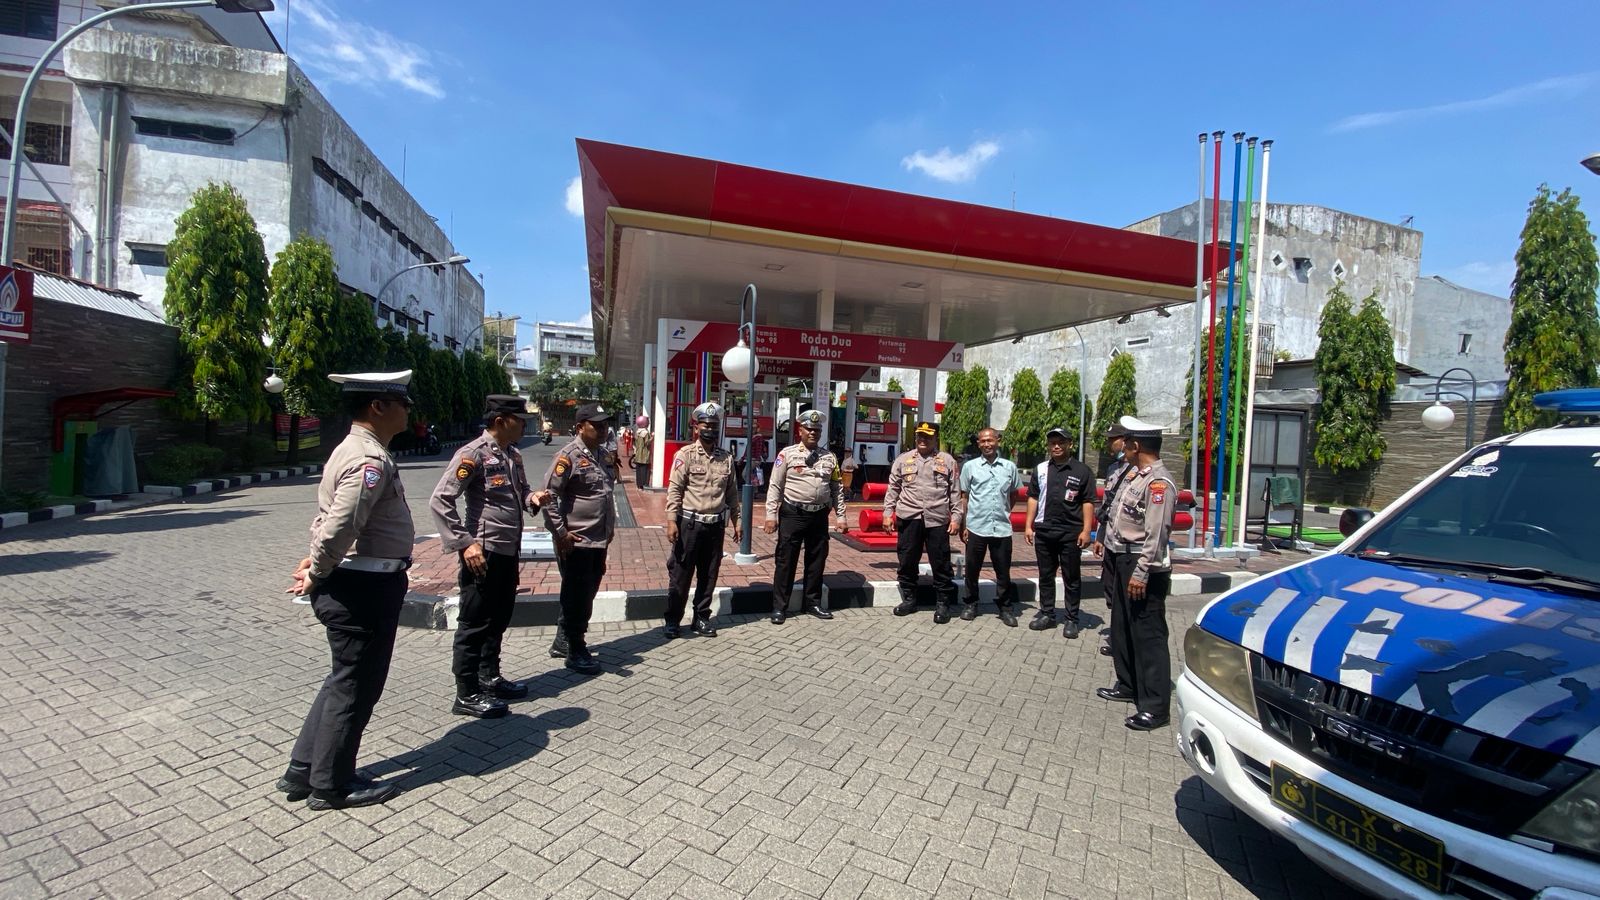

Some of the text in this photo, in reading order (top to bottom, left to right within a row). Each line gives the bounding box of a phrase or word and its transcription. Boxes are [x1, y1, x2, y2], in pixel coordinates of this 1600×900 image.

[800, 332, 852, 347] Roda Dua
[809, 345, 843, 359] Motor
[951, 352, 962, 363] 12
[759, 363, 786, 375] Motor
[870, 368, 879, 377] 10
[1326, 715, 1407, 760] ISUZU
[1360, 807, 1378, 833] X
